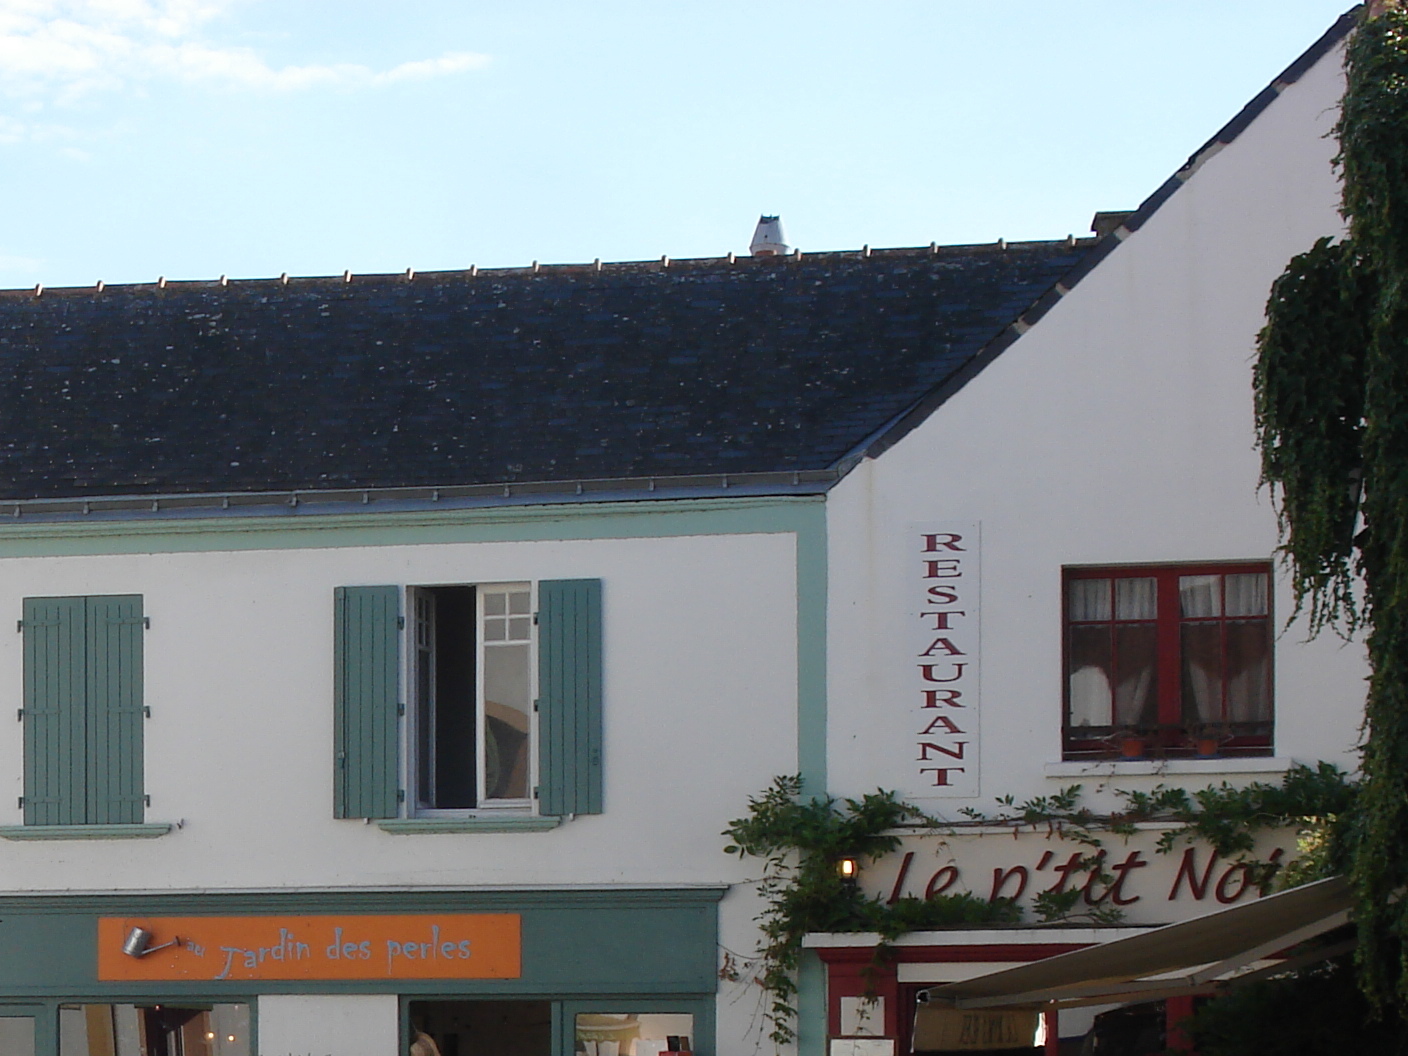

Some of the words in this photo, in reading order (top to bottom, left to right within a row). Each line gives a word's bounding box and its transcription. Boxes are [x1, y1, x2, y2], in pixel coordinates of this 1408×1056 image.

[916, 533, 969, 787] RESTAURANT
[988, 847, 1148, 906] p'tit
[1168, 847, 1284, 904] Noi
[186, 941, 206, 958] au
[326, 926, 371, 960] des
[386, 924, 472, 976] perles
